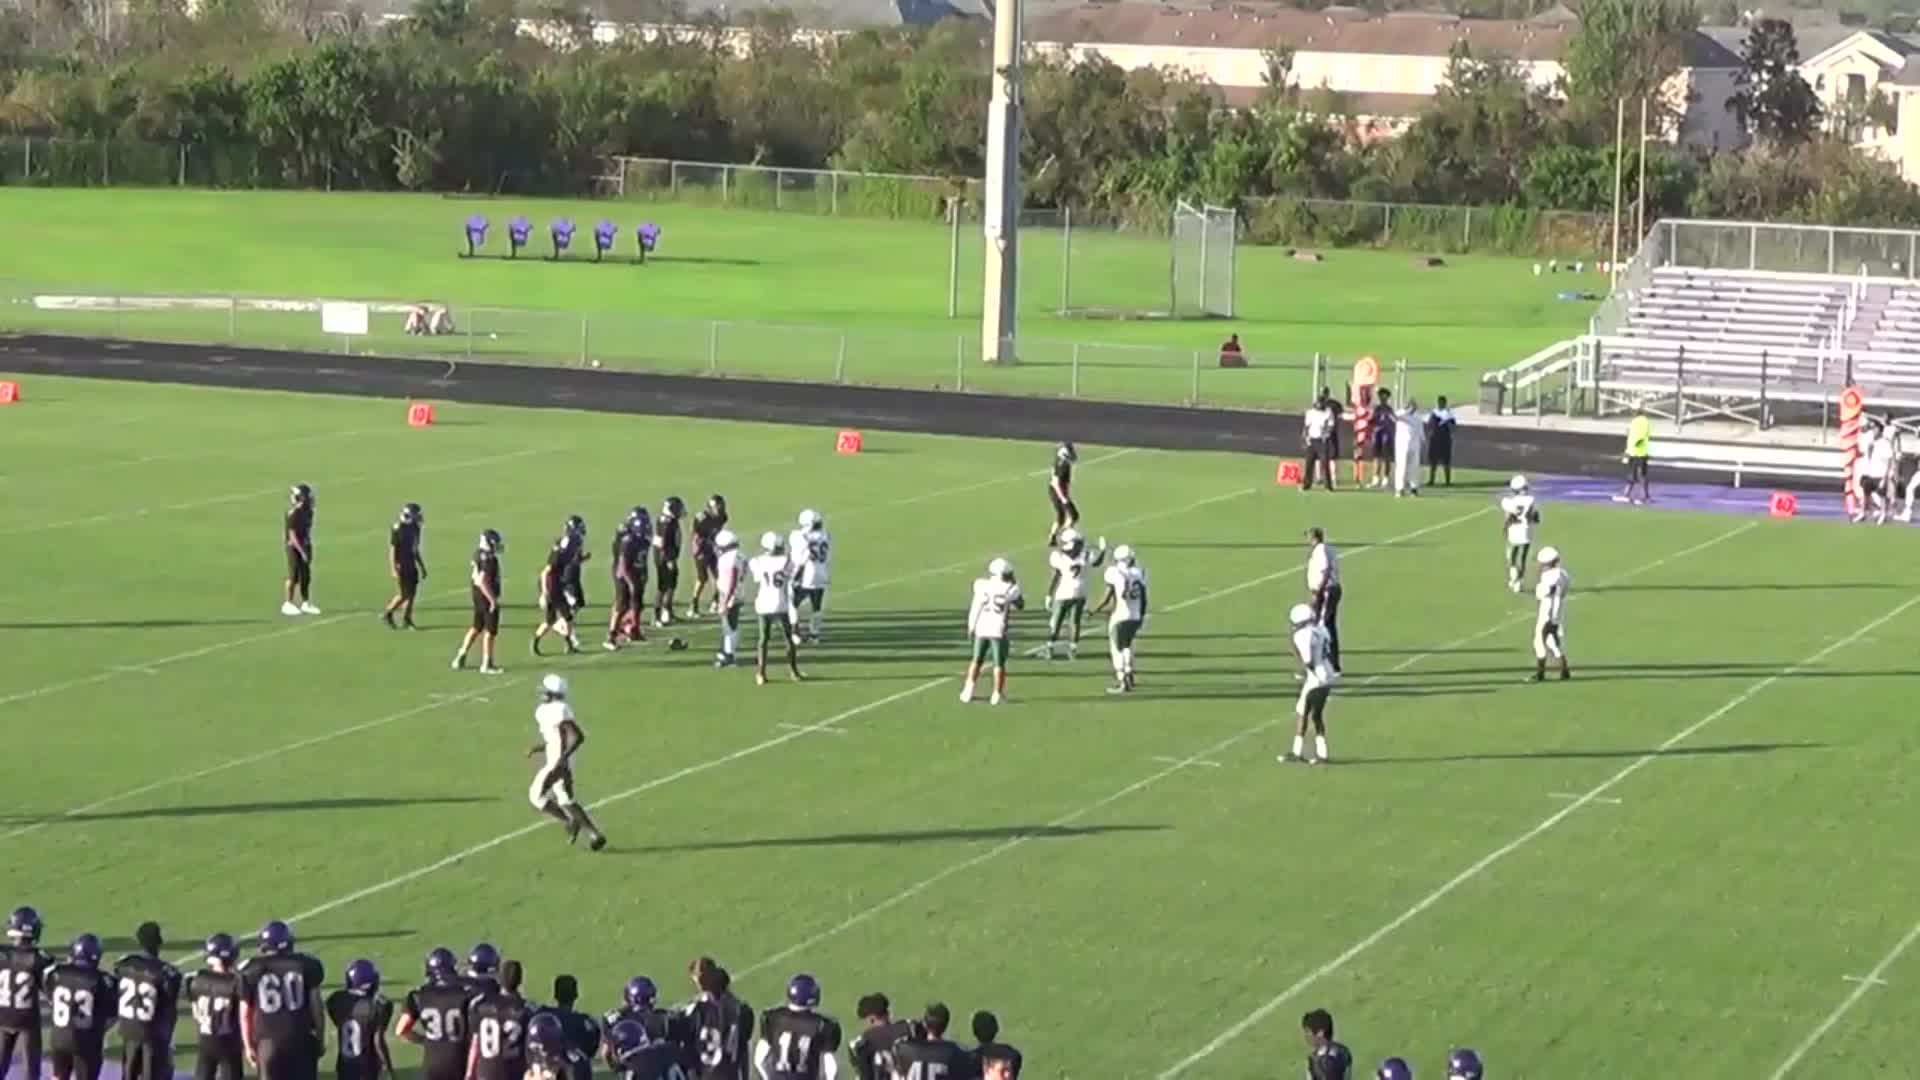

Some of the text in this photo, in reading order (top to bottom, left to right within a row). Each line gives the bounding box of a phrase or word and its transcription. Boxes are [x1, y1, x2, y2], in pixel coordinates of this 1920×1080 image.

[763, 571, 784, 588] 16
[0, 968, 32, 1009] 42
[53, 985, 94, 1029] 63
[118, 976, 157, 1021] 23
[258, 971, 304, 1014] 60
[342, 1019, 361, 1058] 8
[420, 1008, 464, 1042] 30
[480, 1017, 522, 1058] 82
[700, 1024, 740, 1067] 34
[776, 1031, 811, 1072] 11
